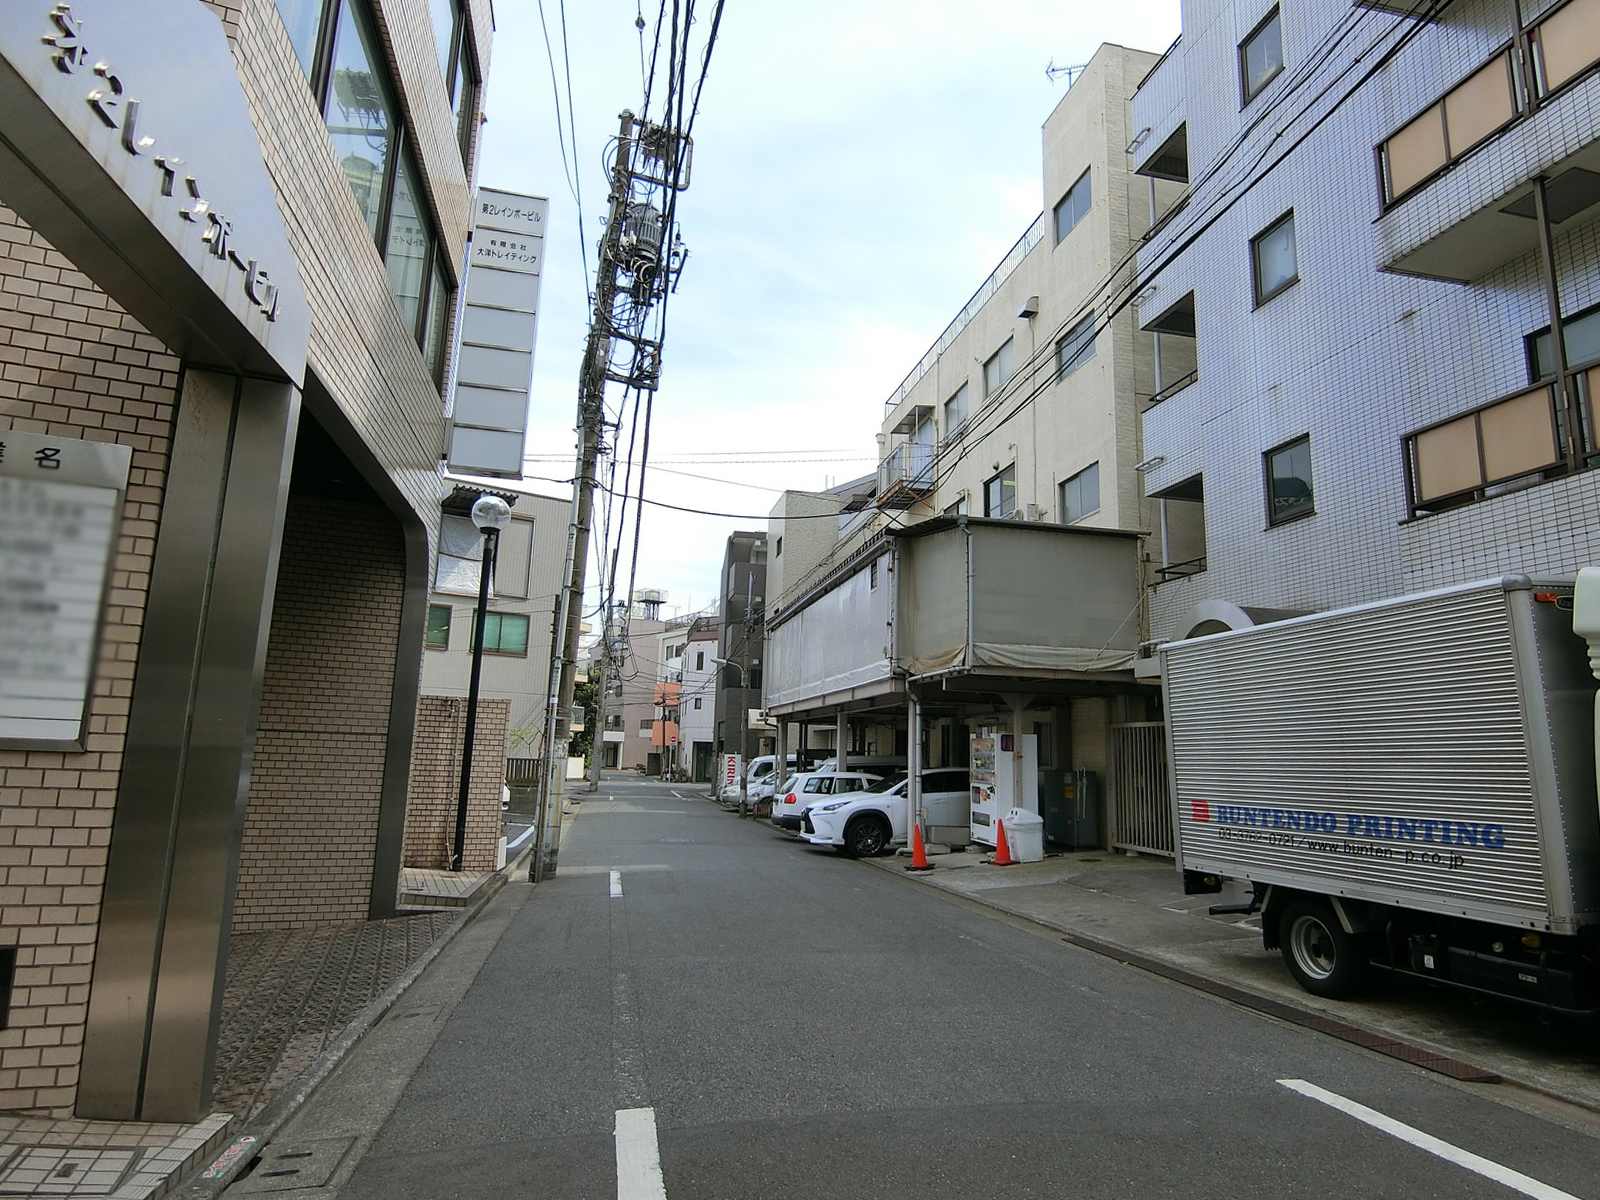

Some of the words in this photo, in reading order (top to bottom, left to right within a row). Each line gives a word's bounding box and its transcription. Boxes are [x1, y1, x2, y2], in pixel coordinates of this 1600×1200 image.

[482, 203, 541, 222] 第2レインボービル
[477, 248, 537, 264] 大洋トレイティング
[1217, 805, 1338, 833] BUNTENDO
[1346, 814, 1506, 849] PRINTING
